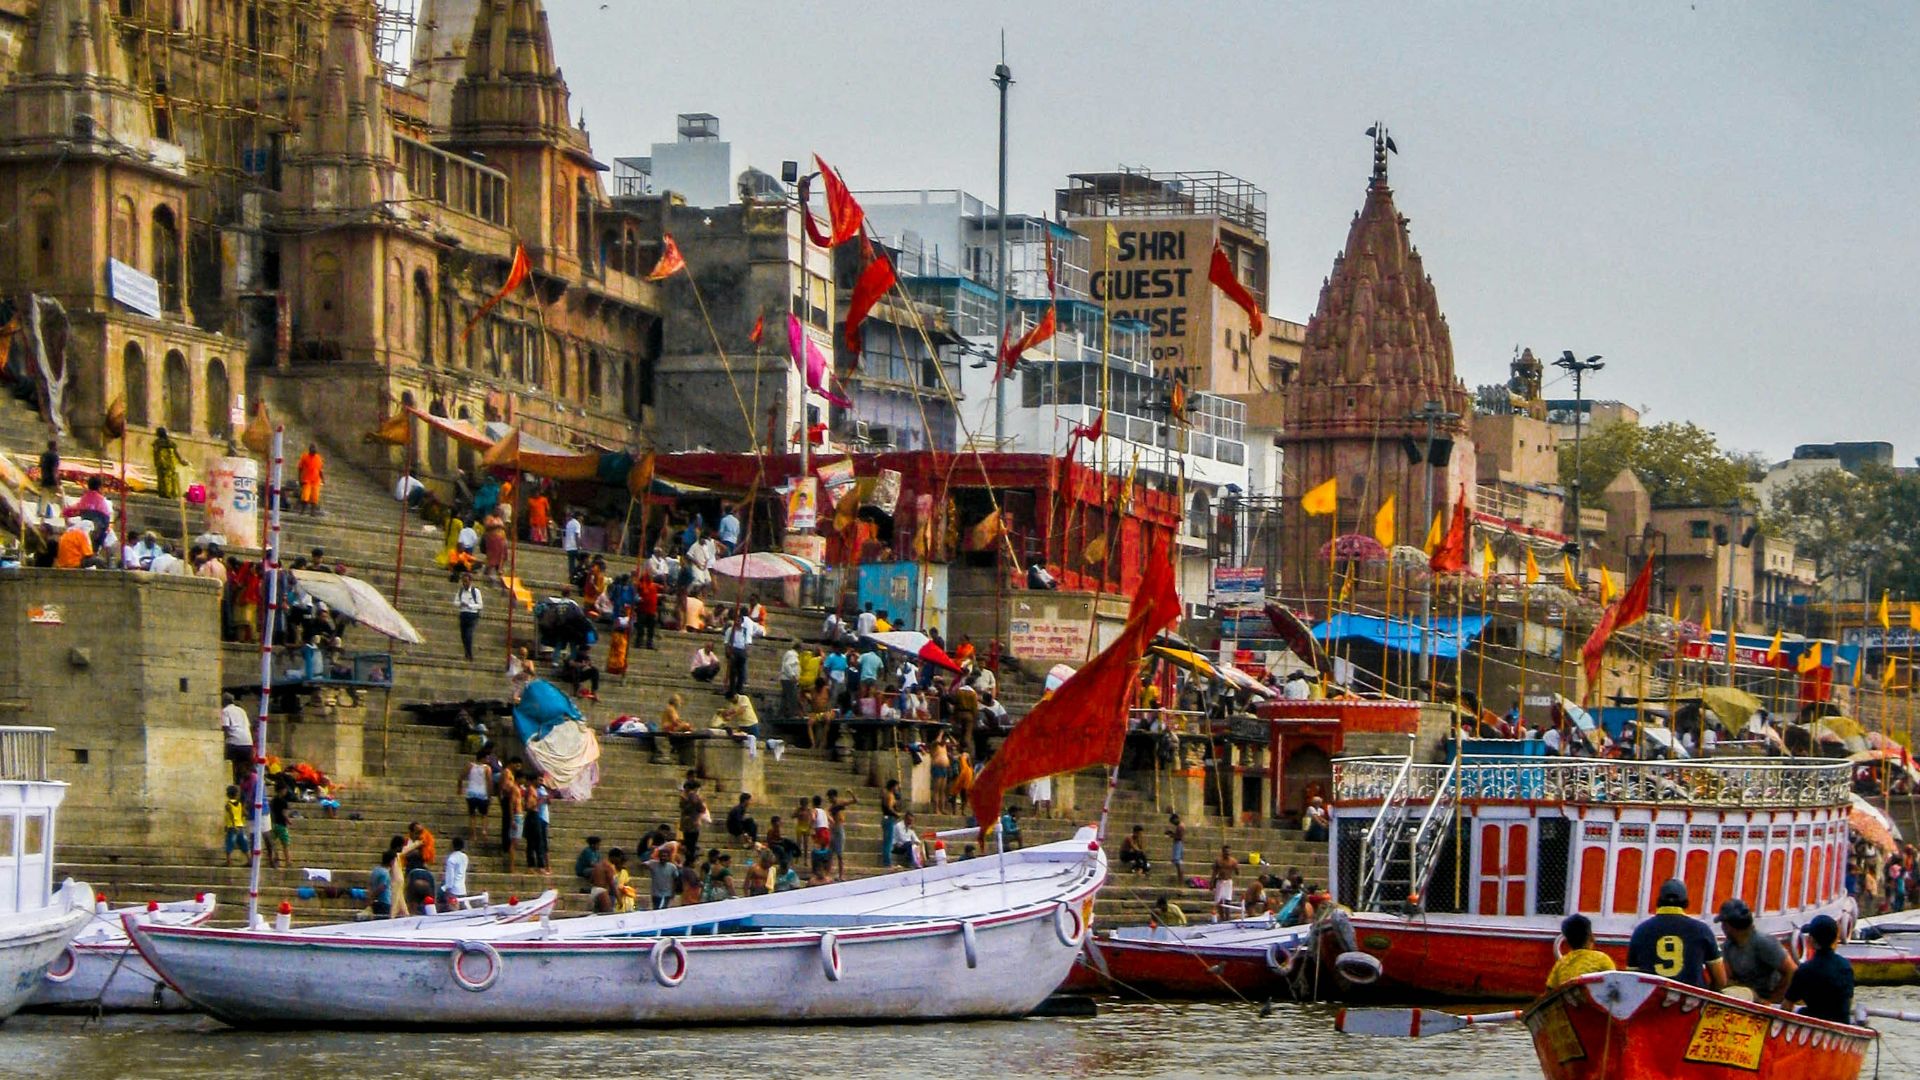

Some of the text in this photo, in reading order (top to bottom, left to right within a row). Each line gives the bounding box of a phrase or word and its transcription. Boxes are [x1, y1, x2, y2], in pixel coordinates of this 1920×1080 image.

[1117, 230, 1185, 262] SHRI
[1090, 268, 1193, 301] GUEST
[1654, 935, 1685, 977] 9
